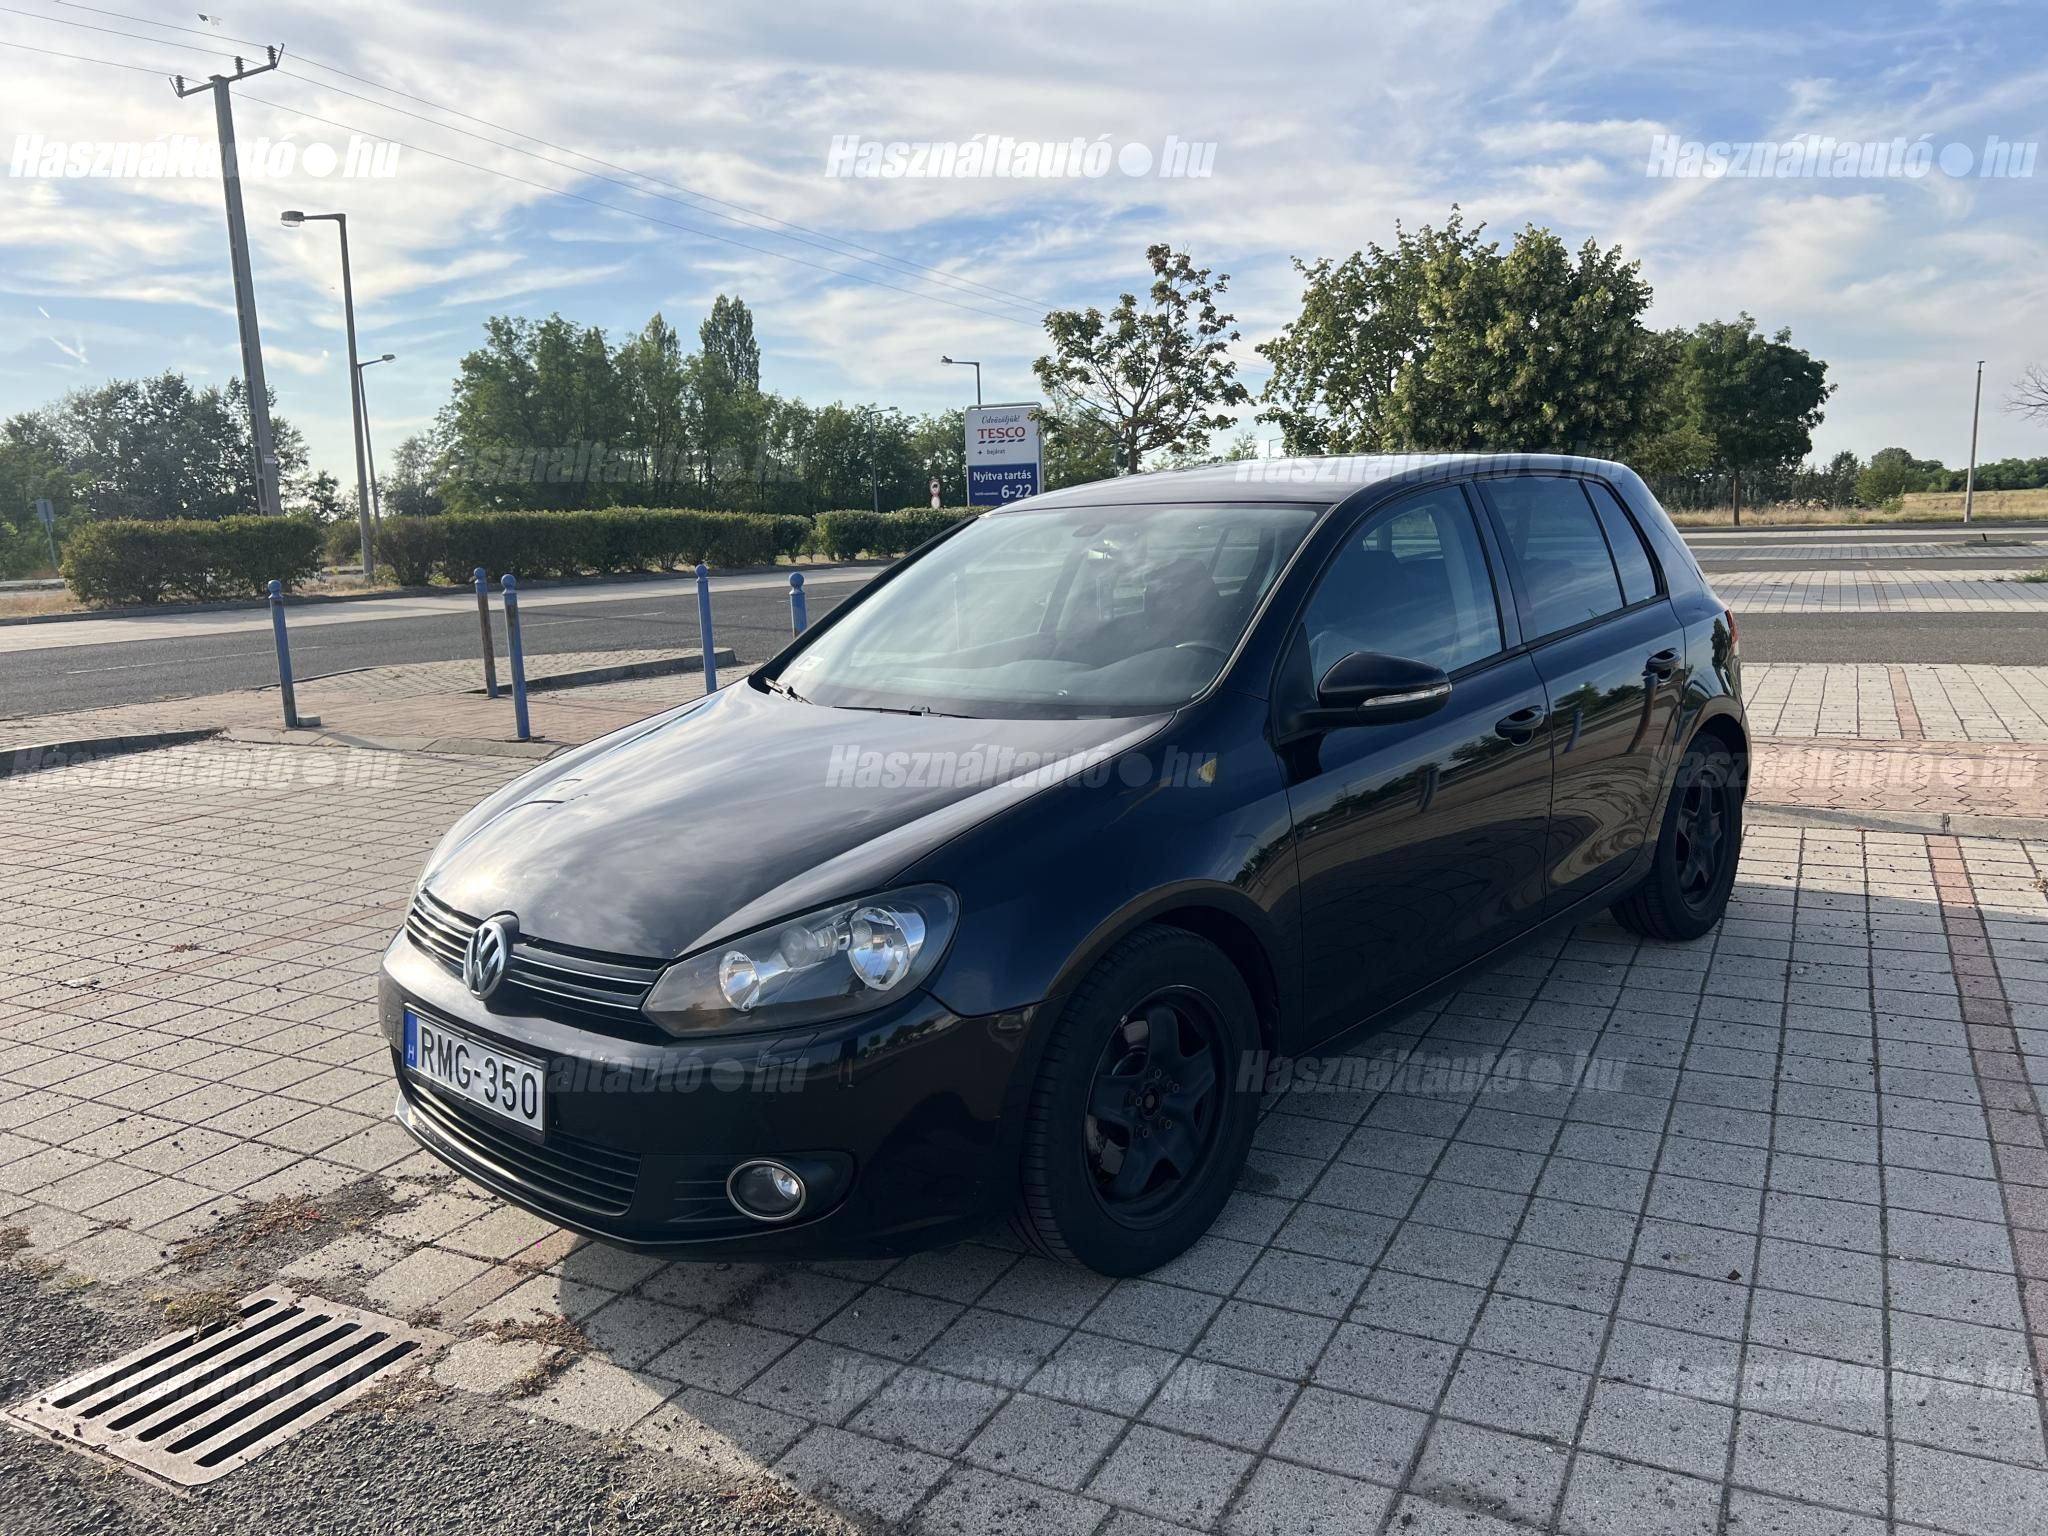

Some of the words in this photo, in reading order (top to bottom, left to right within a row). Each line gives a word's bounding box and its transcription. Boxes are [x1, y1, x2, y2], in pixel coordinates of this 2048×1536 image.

[977, 427, 1026, 439] TESCO
[973, 471, 1001, 483] Nyitva
[1004, 469, 1032, 480] tartás
[1001, 484, 1032, 498] 6-22
[407, 1045, 415, 1060] H
[421, 1025, 538, 1120] RMG-350
